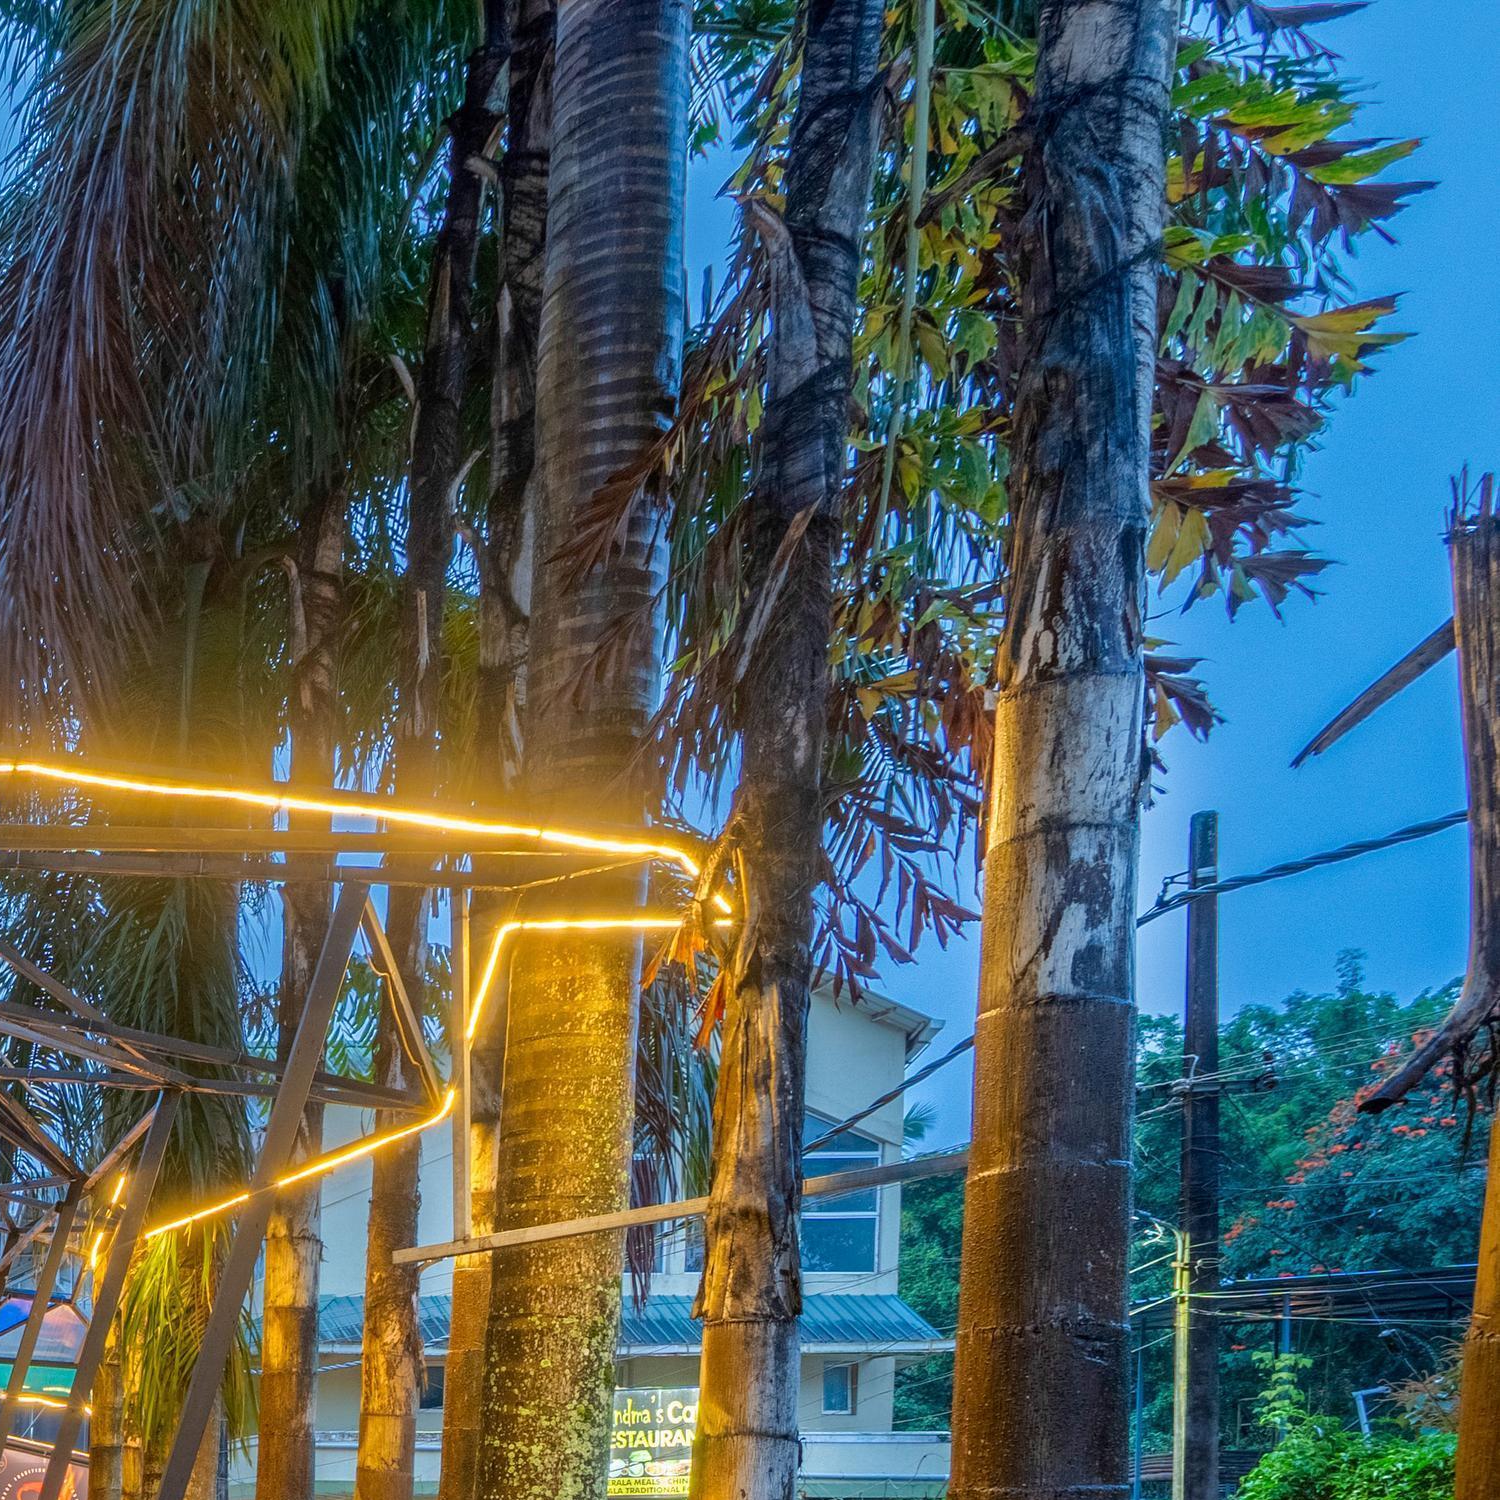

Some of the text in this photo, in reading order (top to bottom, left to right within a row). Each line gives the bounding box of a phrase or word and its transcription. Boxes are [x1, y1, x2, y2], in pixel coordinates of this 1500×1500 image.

[614, 1394, 699, 1427] ndma's Ca
[610, 1429, 696, 1449] ESTAURAN
[668, 1477, 689, 1485] CHIN
[626, 1486, 680, 1494] TRADITIONAL
